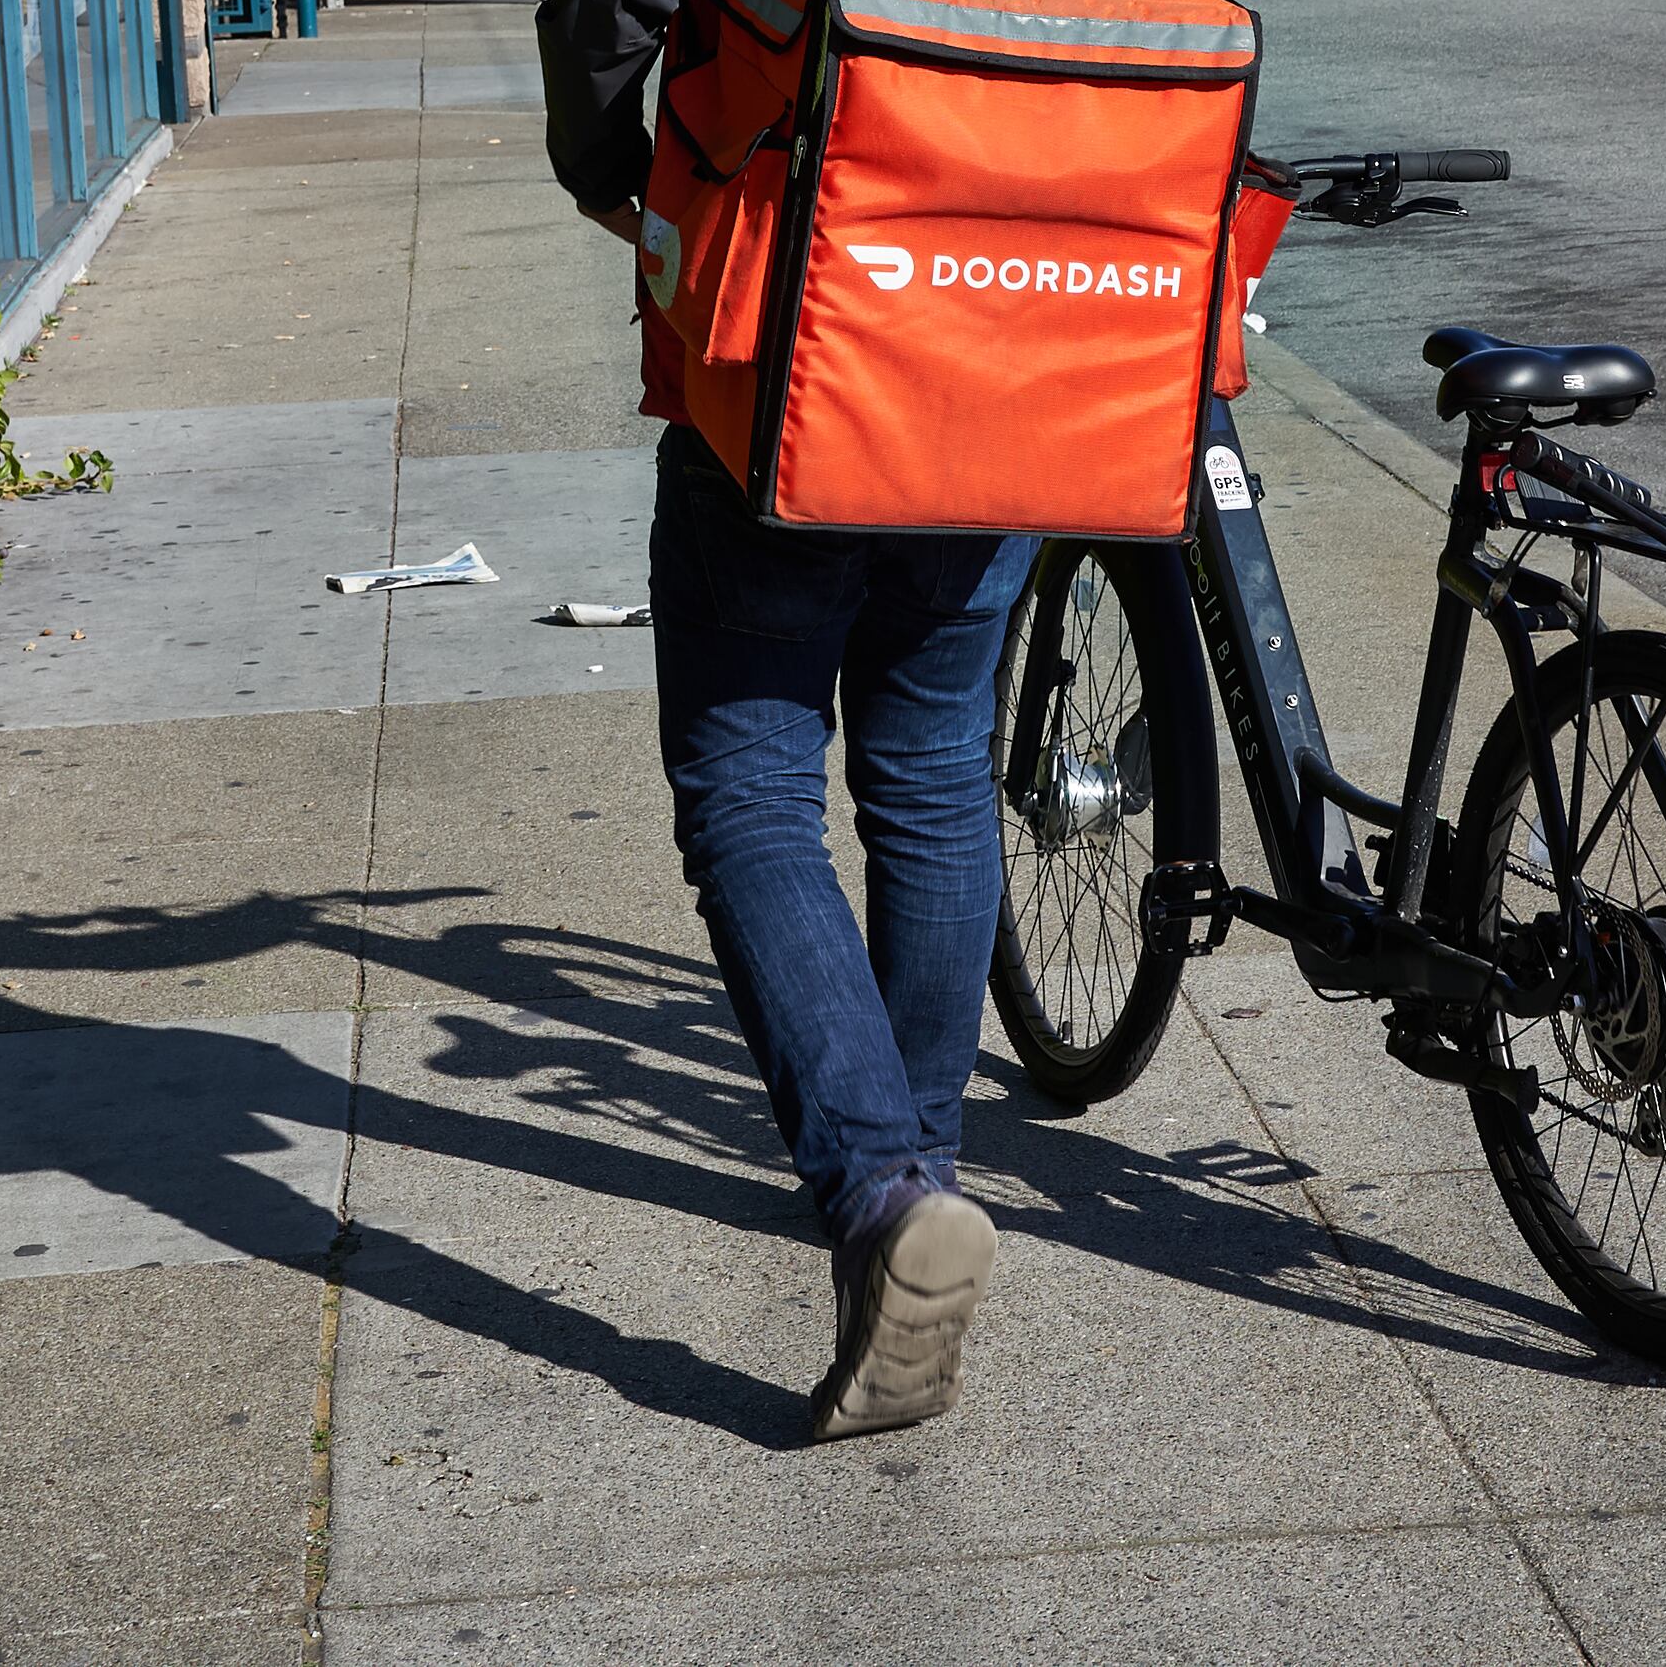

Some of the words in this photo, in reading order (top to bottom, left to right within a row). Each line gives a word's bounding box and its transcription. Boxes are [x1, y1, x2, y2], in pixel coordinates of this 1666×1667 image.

[931, 254, 1182, 298] DOORDASH
[1214, 476, 1242, 489] GPS
[1189, 536, 1222, 625] bolt
[1217, 640, 1259, 761] BIKES
